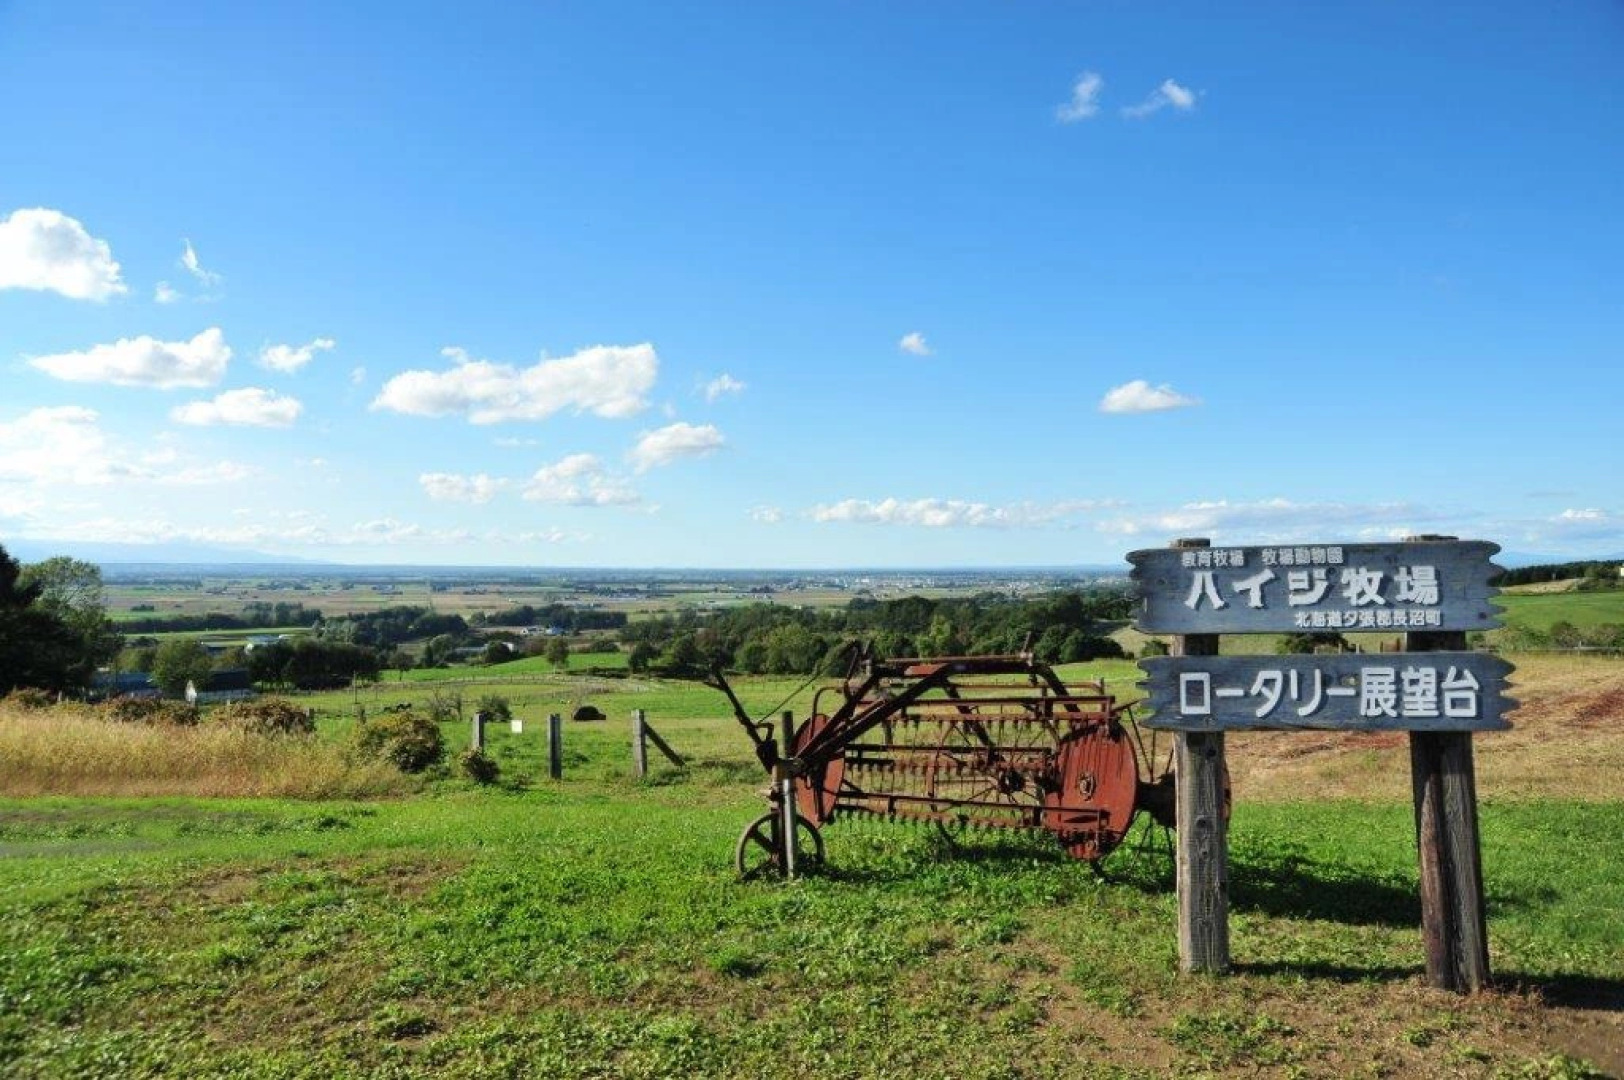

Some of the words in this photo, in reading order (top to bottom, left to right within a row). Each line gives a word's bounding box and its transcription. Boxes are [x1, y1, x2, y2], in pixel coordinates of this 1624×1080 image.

[1184, 565, 1440, 610] ハイジ牧場
[1294, 609, 1441, 627] 北海道夕張郡長沼町
[1179, 665, 1480, 718] ロータリー展望台
